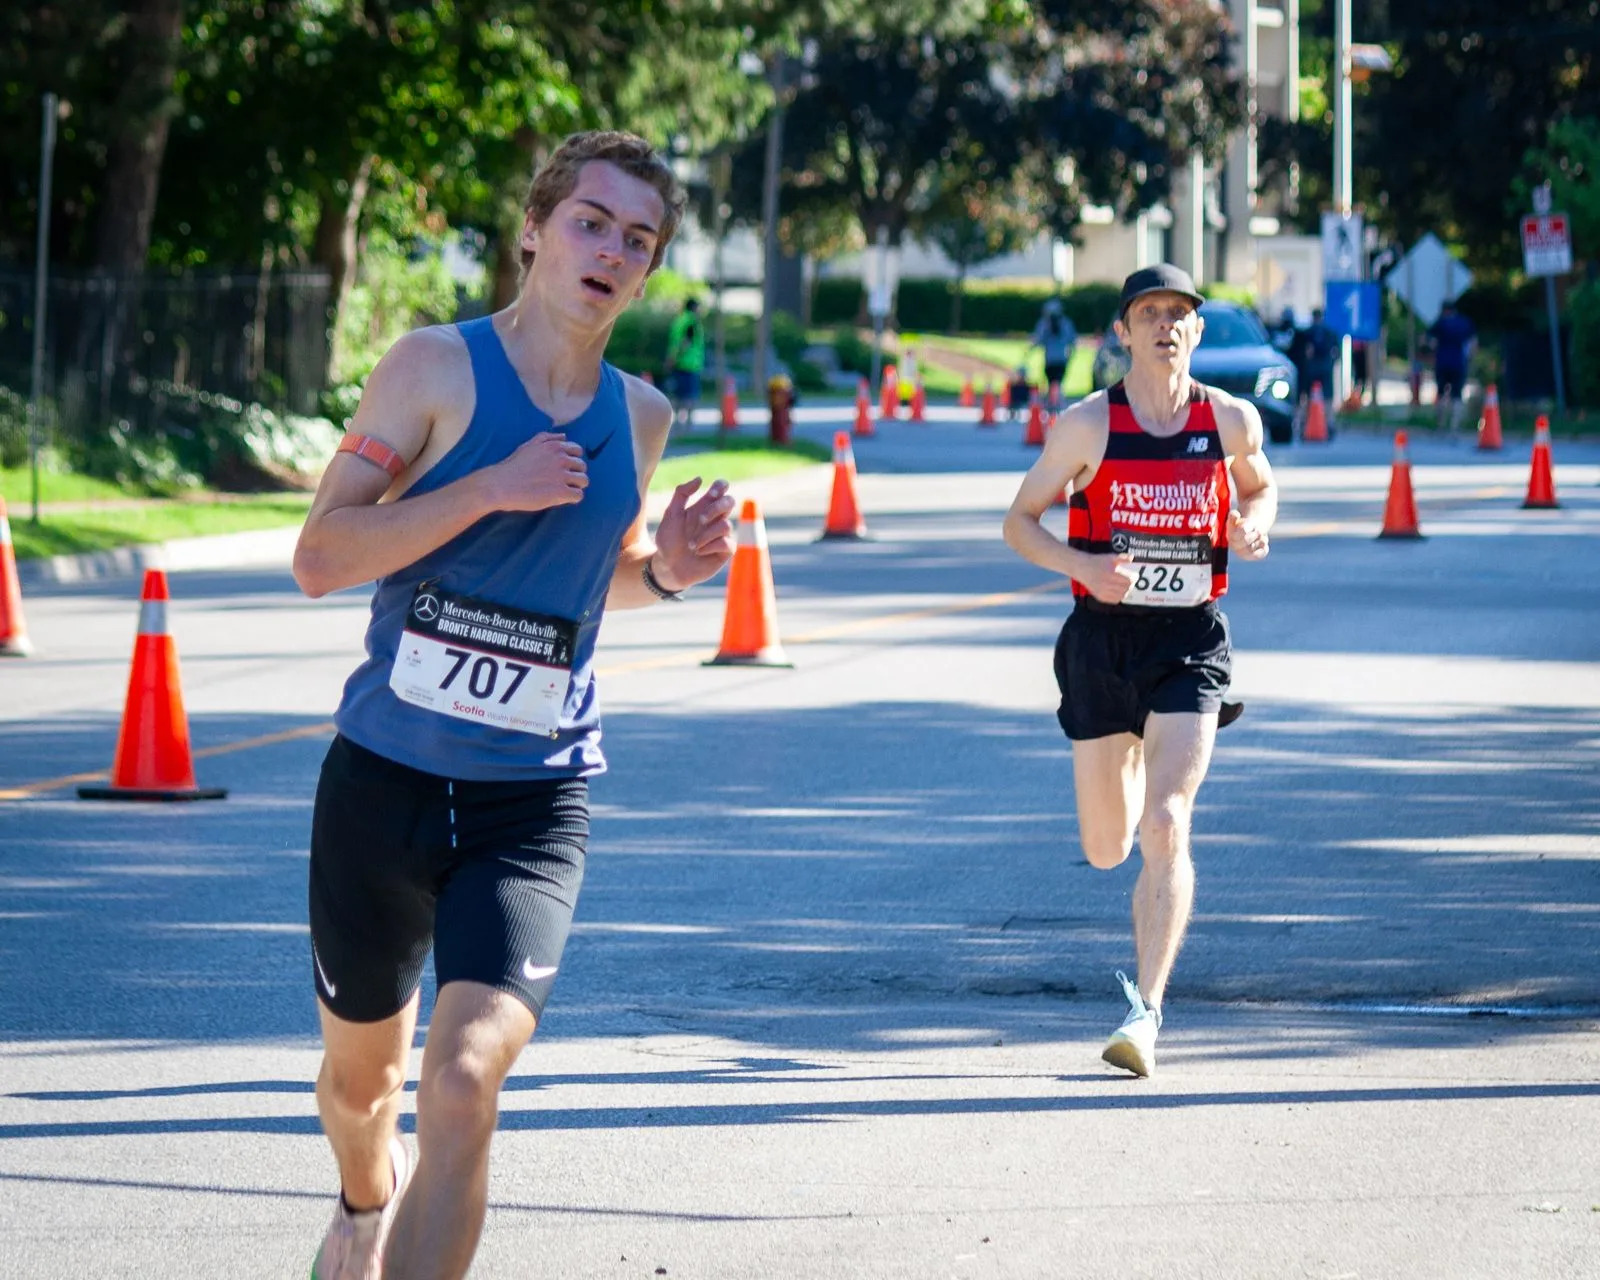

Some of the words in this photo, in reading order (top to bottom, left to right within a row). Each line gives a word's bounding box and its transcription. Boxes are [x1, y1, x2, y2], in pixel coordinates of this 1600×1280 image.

[1187, 437, 1209, 454] NB
[1135, 566, 1184, 591] 626
[442, 600, 517, 631] Mercedes-Benz
[518, 618, 558, 640] Oakville
[438, 618, 469, 637] BRONTE
[470, 626, 508, 647] HARBOUR
[510, 636, 542, 655] CLASSIC
[542, 642, 554, 657] 5K
[438, 647, 532, 705] 707
[453, 701, 485, 717] Scotia
[486, 711, 509, 724] Wealth
[509, 715, 547, 731] Management
